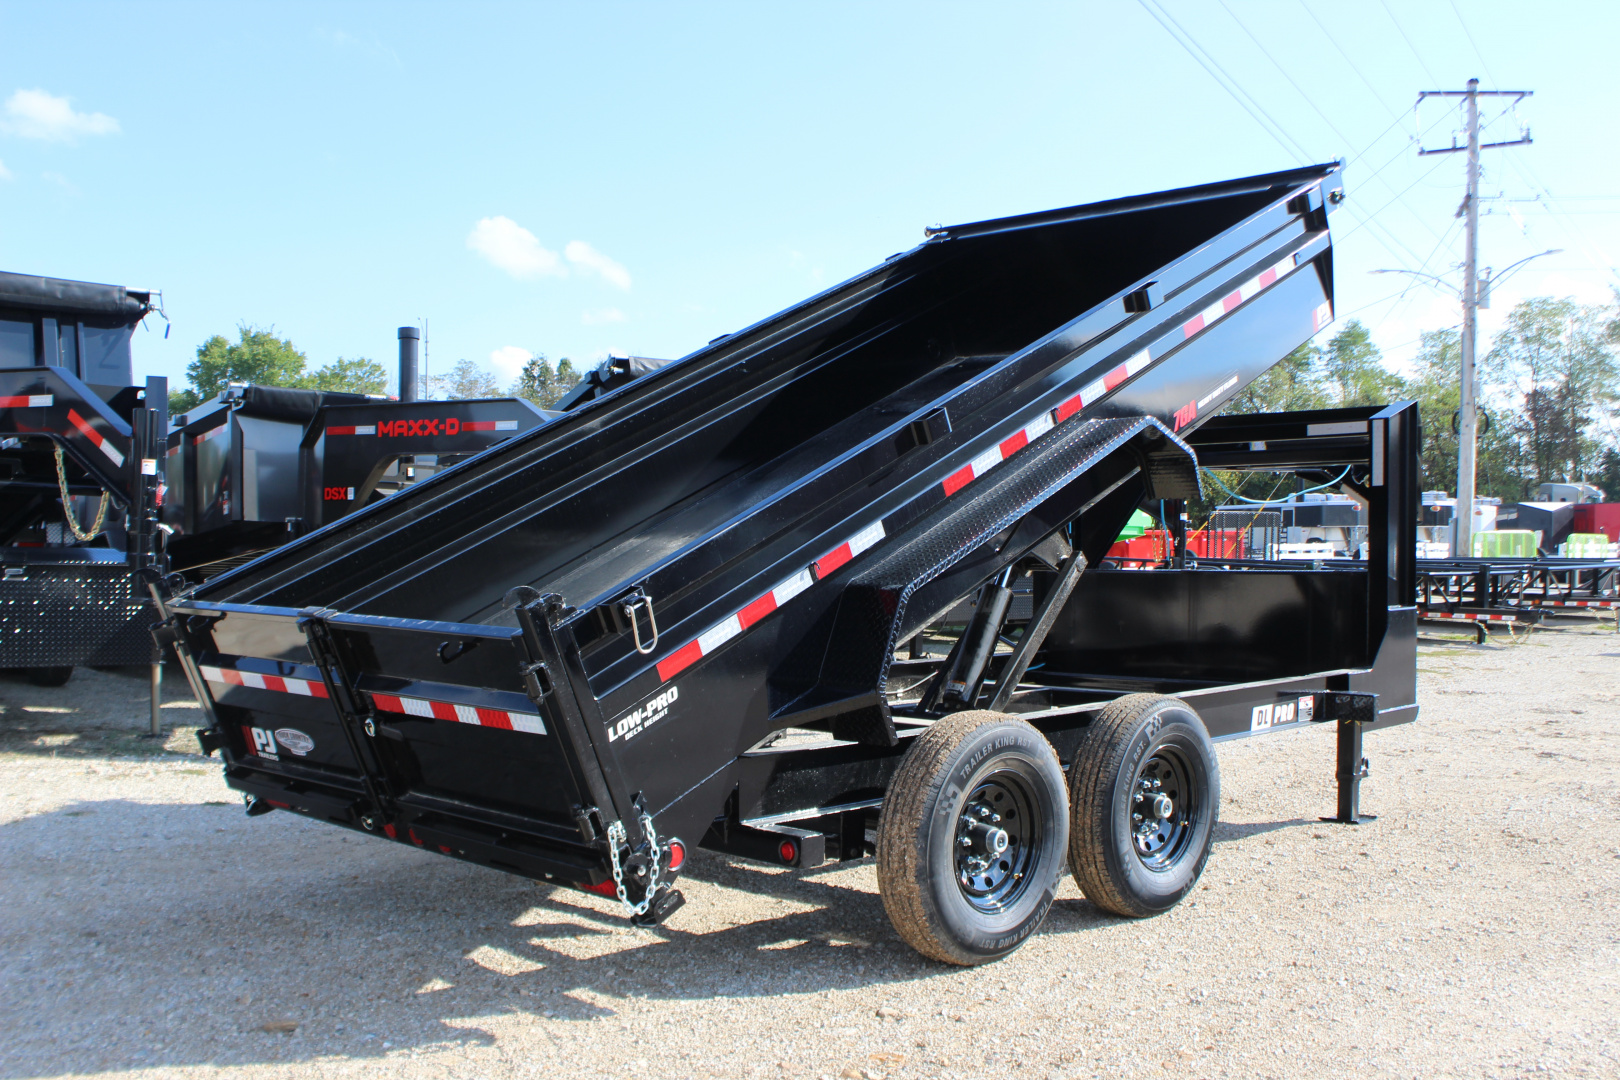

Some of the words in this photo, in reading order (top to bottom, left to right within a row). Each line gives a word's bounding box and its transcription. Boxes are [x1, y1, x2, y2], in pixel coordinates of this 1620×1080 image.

[378, 418, 459, 437] MAXX-D
[1174, 400, 1197, 433] 7GA
[324, 487, 346, 500] DSX
[608, 686, 678, 743] LOW-PRO
[625, 724, 643, 741] DECK
[644, 708, 668, 728] HEIGHT
[1257, 709, 1268, 726] DL
[1273, 703, 1295, 724] PRO
[251, 727, 278, 754] PJ
[960, 743, 993, 780] TRAILER
[995, 736, 1015, 750] KING
[1017, 737, 1031, 748] RST
[1123, 762, 1135, 792] KING
[1020, 902, 1049, 936] TRAILER
[979, 938, 996, 949] RST
[998, 934, 1018, 948] KING
